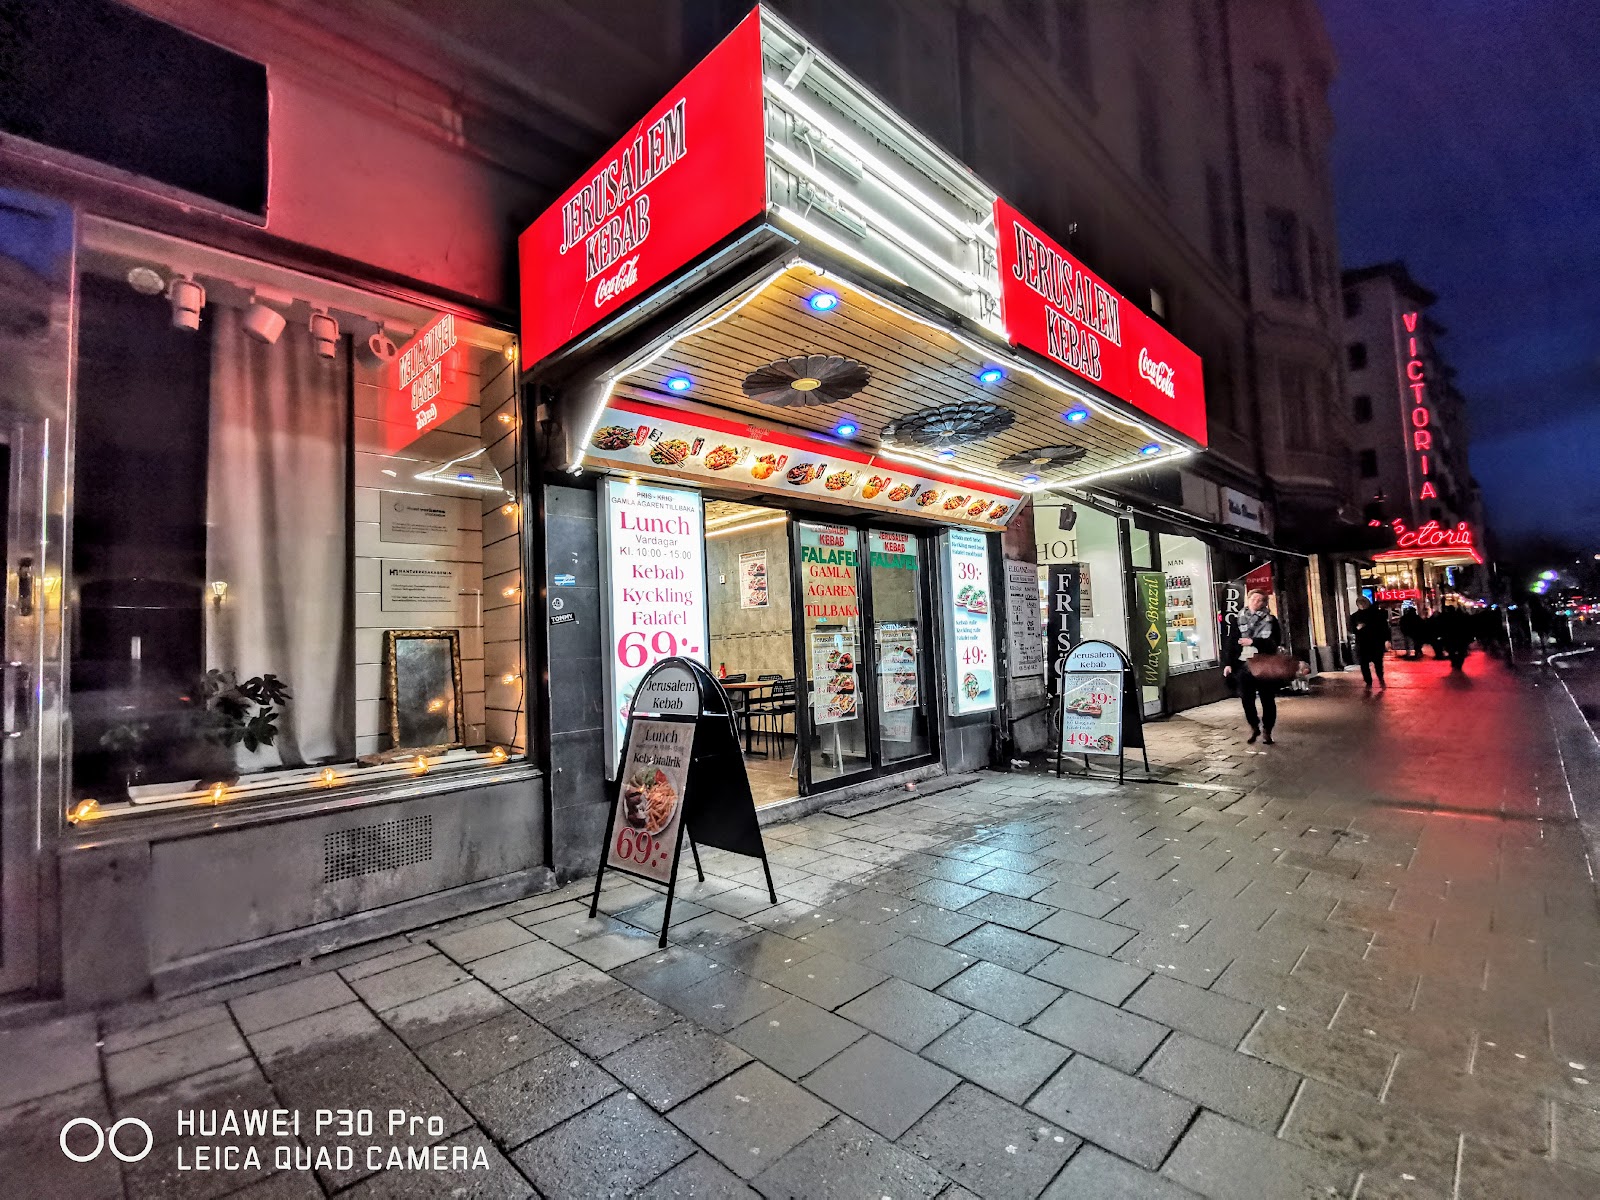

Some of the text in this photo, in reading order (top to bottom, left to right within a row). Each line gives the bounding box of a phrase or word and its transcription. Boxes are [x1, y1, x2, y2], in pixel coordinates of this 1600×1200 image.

[560, 97, 687, 255] JERUSALEM
[585, 194, 650, 283] KEBAB
[1012, 220, 1122, 347] JERUSALEM
[1045, 305, 1102, 382] KEBAB
[1402, 312, 1437, 499] VICTORIA
[620, 511, 690, 535] Lunch
[635, 534, 678, 547] Vardagar
[819, 533, 845, 547] KEBAB
[878, 531, 909, 543] JERUSALEM
[637, 547, 662, 558] 10:00
[670, 550, 692, 560] 15:00
[884, 541, 906, 553] KEBAB
[801, 546, 860, 567] FALAFEL
[870, 552, 918, 571] FALAFEL
[632, 564, 685, 580] Kebab
[810, 565, 851, 579] GAMLA
[958, 562, 982, 580] 39:-
[623, 588, 693, 606] Kyckling
[1142, 575, 1160, 622] Brazil
[550, 613, 574, 622] TOMMY
[632, 610, 687, 625] Falafel
[805, 604, 859, 617] TILLBAKA
[962, 646, 987, 665] 49:-
[1072, 651, 1115, 660] Jerusalem
[646, 679, 696, 692] Jerusalem
[652, 697, 683, 709] Kebab
[645, 729, 678, 744] Lunch
[1066, 732, 1098, 746] 49:-
[616, 826, 668, 868] 69:-
